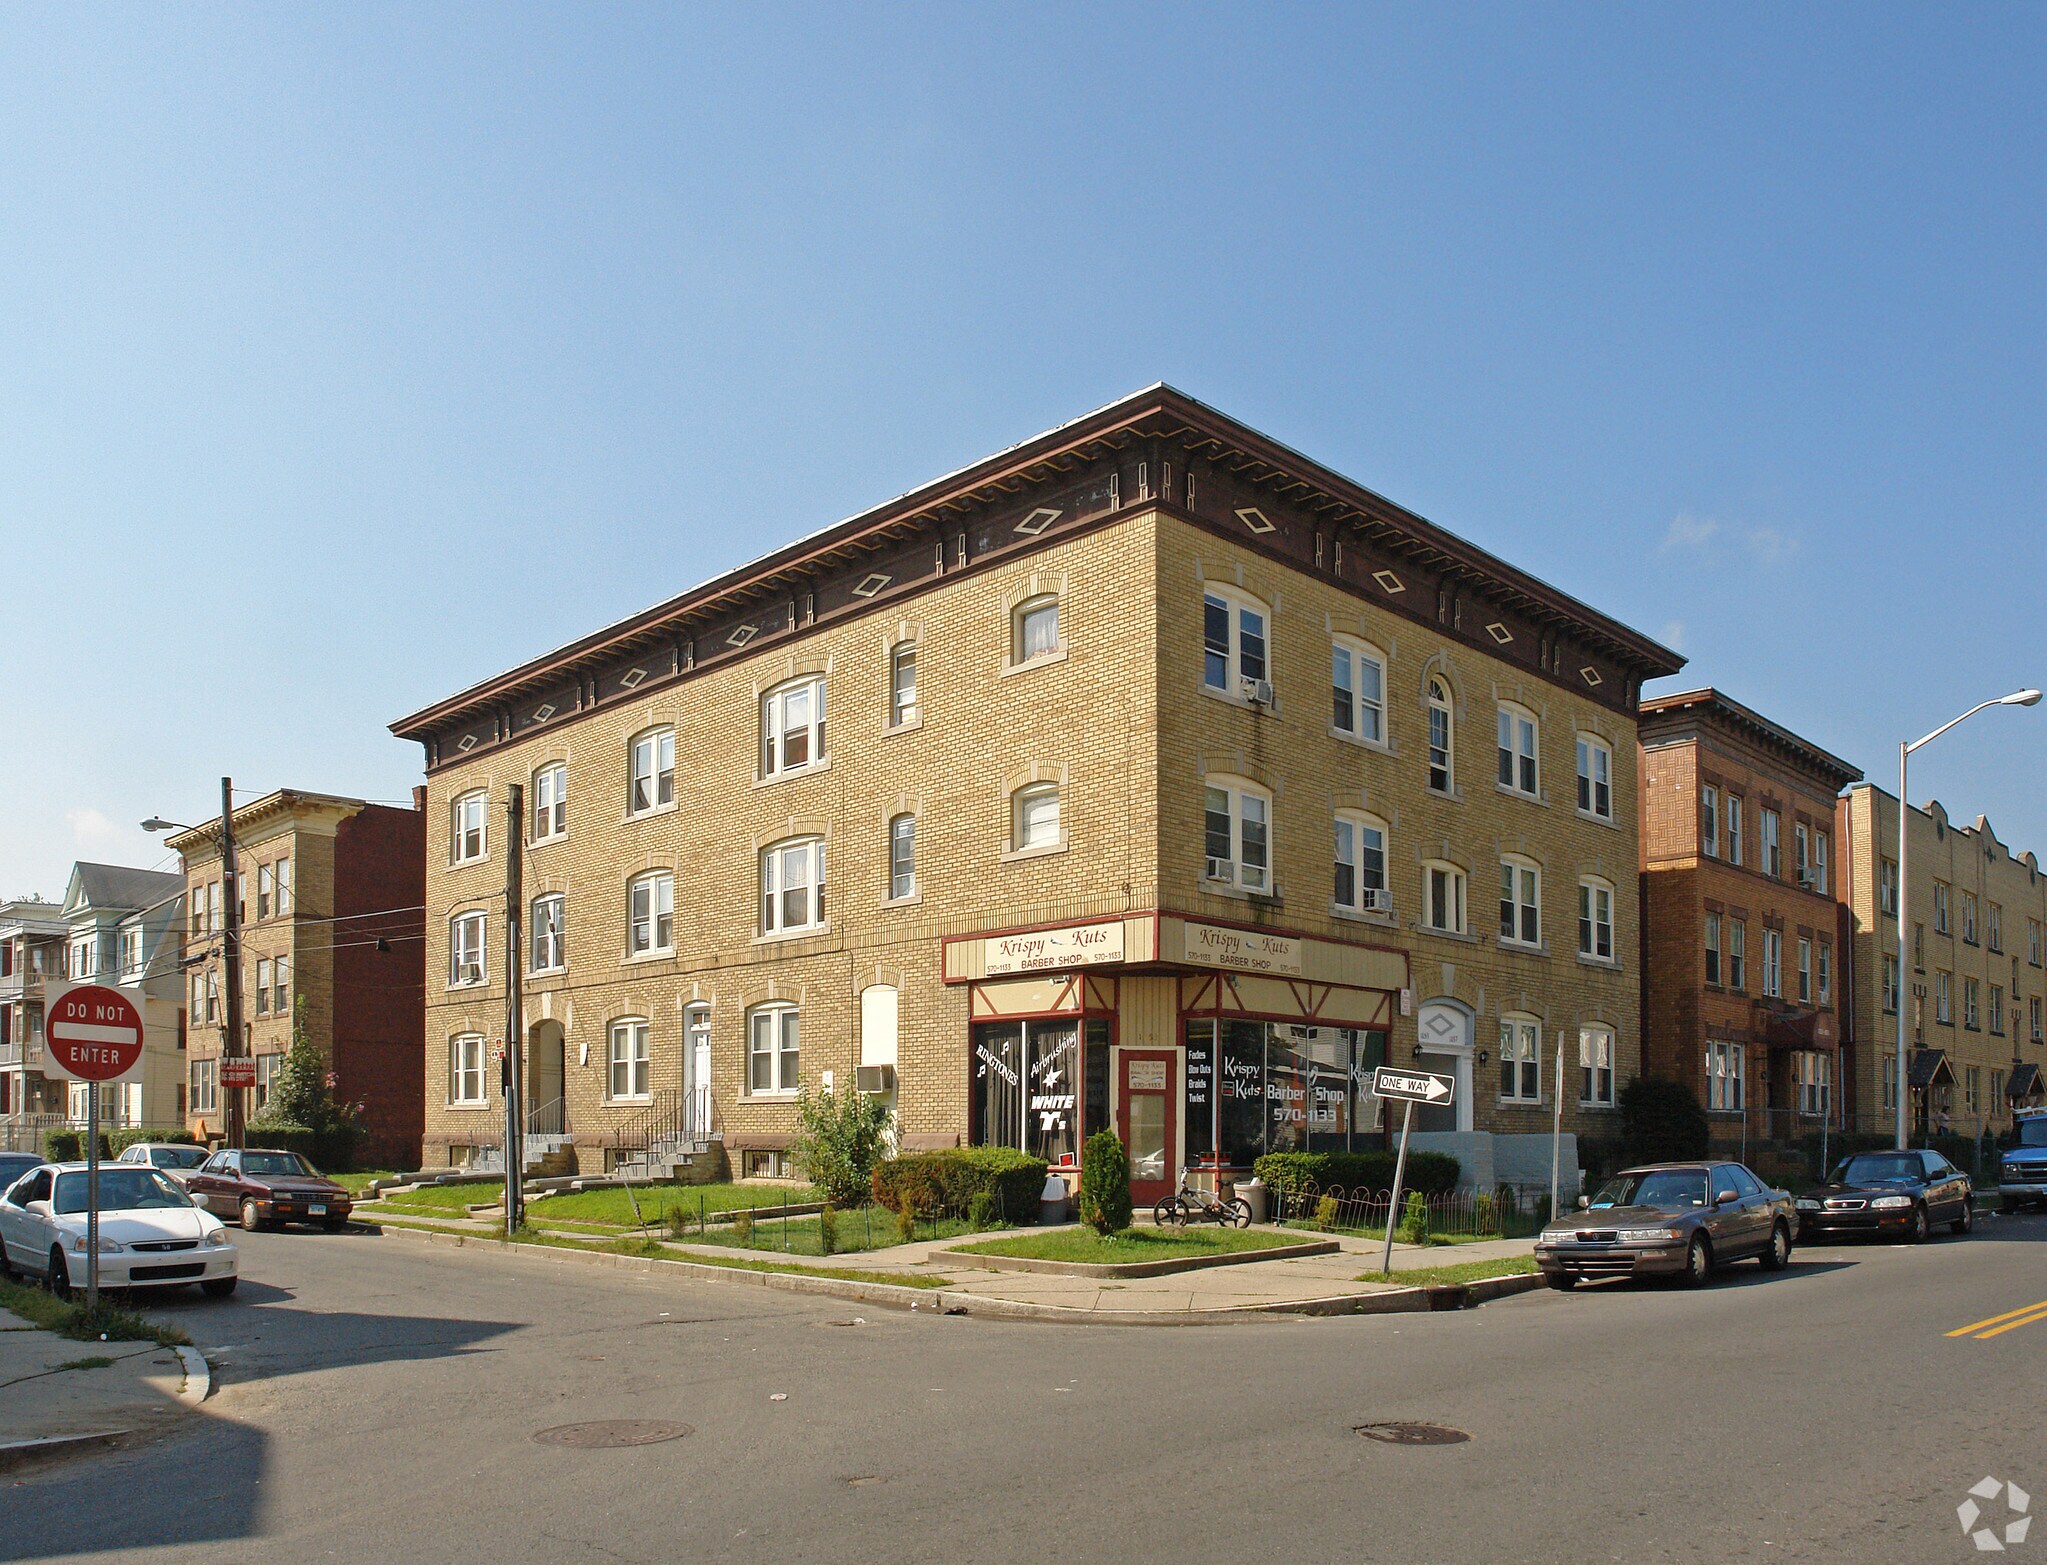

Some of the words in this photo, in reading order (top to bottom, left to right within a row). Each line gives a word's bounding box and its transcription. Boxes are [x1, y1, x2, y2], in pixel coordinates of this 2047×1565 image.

[1000, 938, 1045, 958] Krispy
[1071, 929, 1107, 947] Kuts
[1200, 929, 1240, 954] Krispy
[1262, 938, 1290, 955] Kuts
[987, 963, 1011, 973] 570-1133
[1021, 957, 1054, 969] BARBER
[1058, 954, 1083, 965] SHOP
[1094, 951, 1121, 961] 570-1133
[1188, 951, 1211, 961] 570-1133
[1220, 954, 1249, 967] BARBER
[1252, 959, 1271, 969] SHOP
[67, 1002, 87, 1018] DO
[96, 1005, 124, 1021] NOT
[70, 1047, 119, 1064] ENTER
[976, 1044, 1019, 1086] RINGTONES
[1030, 1032, 1077, 1079] Airbrushing
[1188, 1050, 1206, 1060] Fades
[1225, 1056, 1260, 1079] Krispy
[1350, 1063, 1375, 1084] Krisp
[1188, 1079, 1207, 1089] Braids
[1235, 1079, 1261, 1100] Kuts
[1381, 1077, 1403, 1089] ONE
[1407, 1081, 1430, 1092] WAY
[1031, 1095, 1075, 1110] WHITE
[1189, 1093, 1206, 1103] Twist
[1267, 1084, 1305, 1100] Barber
[1315, 1087, 1344, 1105] Shop
[1039, 1111, 1067, 1131] T's
[1273, 1108, 1337, 1122] 570-1133
